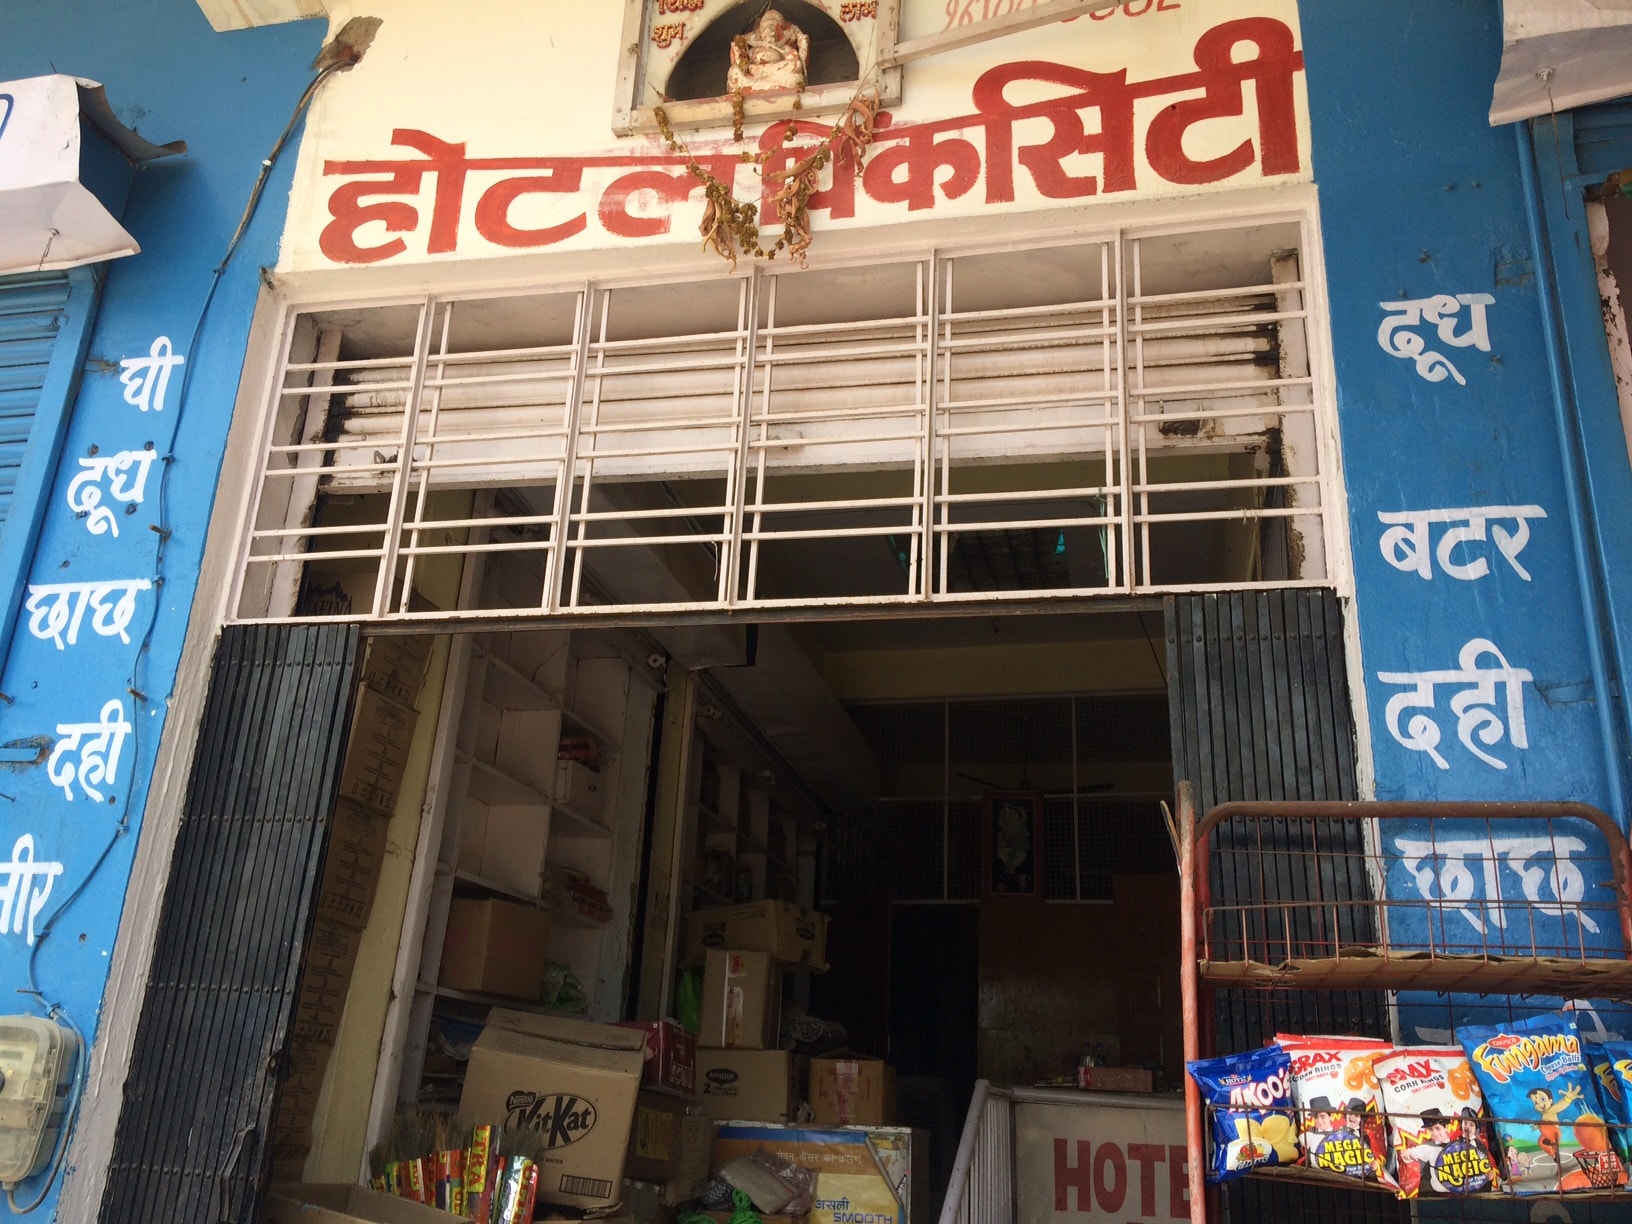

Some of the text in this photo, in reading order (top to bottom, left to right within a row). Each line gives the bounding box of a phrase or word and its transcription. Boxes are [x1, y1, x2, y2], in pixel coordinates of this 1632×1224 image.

[318, 128, 744, 264] होटल
[1377, 293, 1496, 386] दूध
[119, 335, 185, 412] घी
[66, 449, 157, 538] दूध
[1377, 505, 1548, 582] बटर
[26, 578, 152, 651] छाछ
[1377, 638, 1533, 770] दही
[47, 699, 132, 802] दही
[1394, 835, 1601, 935] छाछ
[1315, 1063, 1343, 1075] RINGS
[1394, 1080, 1418, 1093] CORN
[1473, 1033, 1581, 1084] Fungama
[1318, 1149, 1375, 1173] MAGIC
[1324, 1138, 1362, 1153] MEGA
[1438, 1158, 1491, 1187] MAGIC
[1442, 1150, 1479, 1164] MEGA
[815, 1196, 850, 1212] असली
[832, 1212, 894, 1224] SMOOTH
